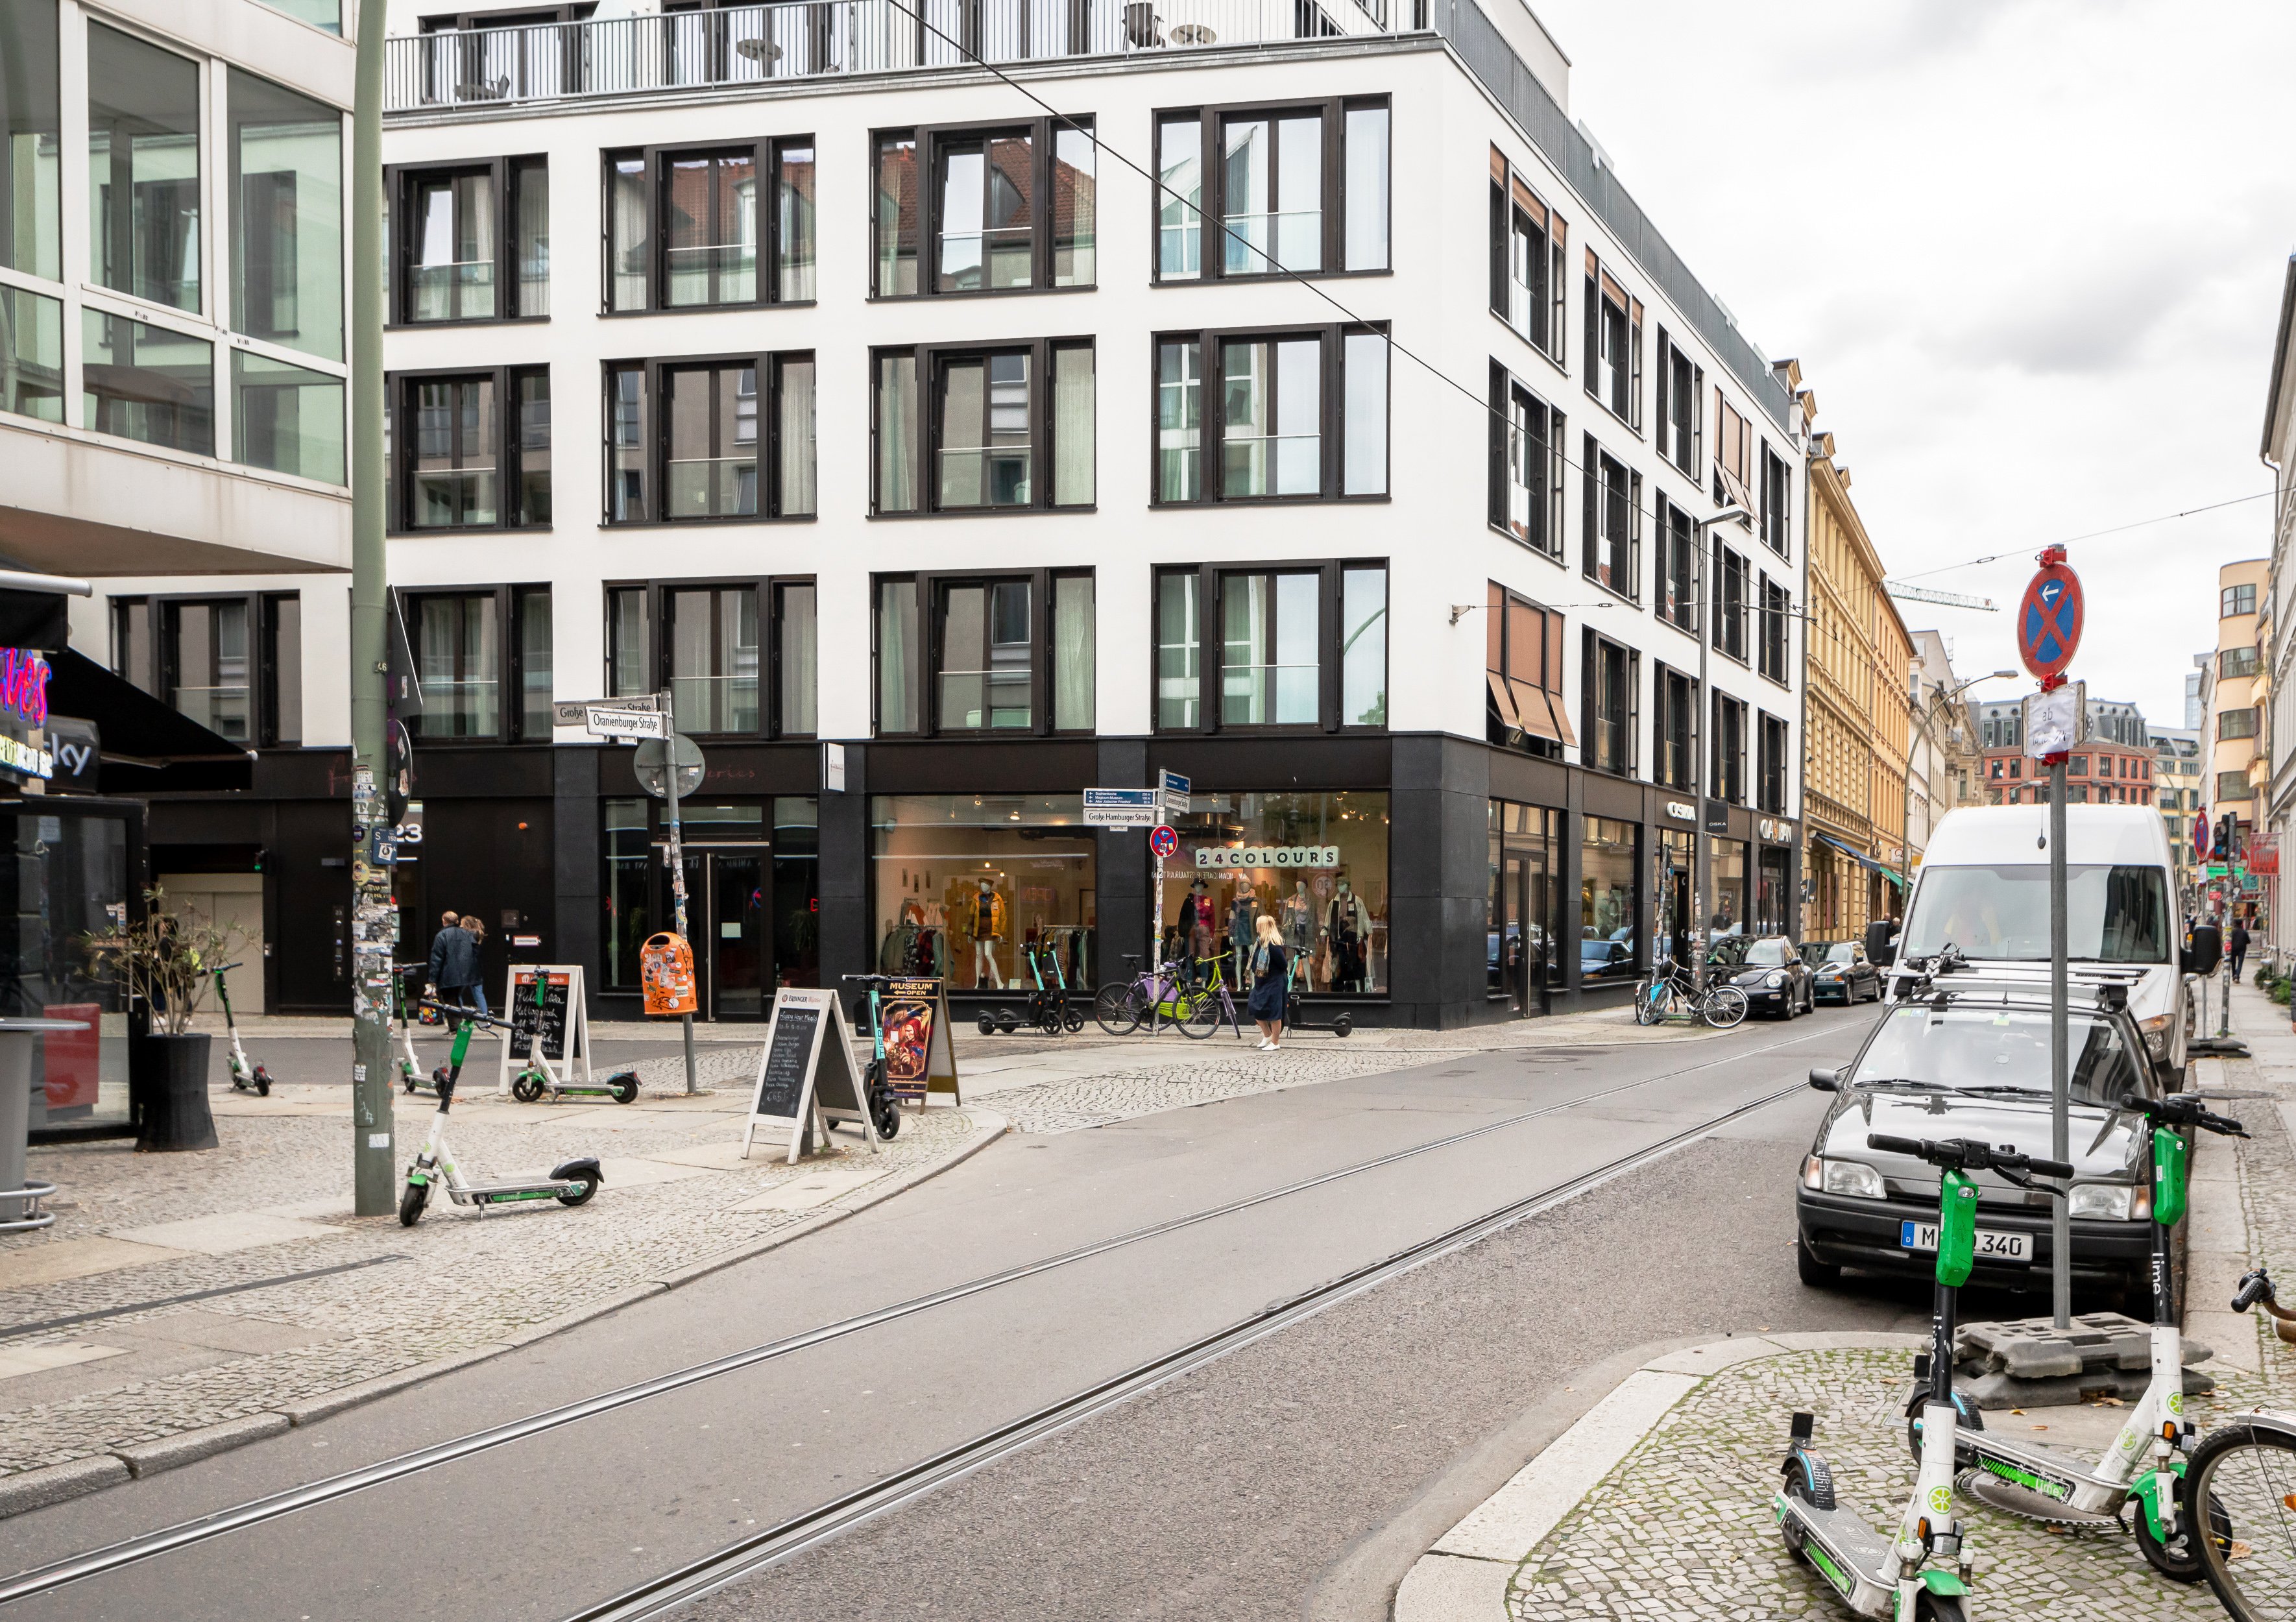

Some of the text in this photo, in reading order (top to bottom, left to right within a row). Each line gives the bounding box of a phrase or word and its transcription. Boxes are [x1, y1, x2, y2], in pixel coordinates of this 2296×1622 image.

[560, 707, 583, 720] Große
[2042, 707, 2053, 721] ab
[593, 714, 657, 732] Oranienburger Straße
[43, 732, 91, 777] ky
[1089, 812, 1151, 823] Große Hamburger Straße
[1667, 801, 1697, 821] OSKA
[374, 831, 381, 841] S
[889, 982, 933, 991] MUSEUM
[788, 995, 808, 1003] ERDINGER
[779, 1011, 793, 1021] Happy
[804, 1013, 817, 1021] Meals
[1981, 1233, 2022, 1256] 340
[2035, 1477, 2060, 1497] Lime
